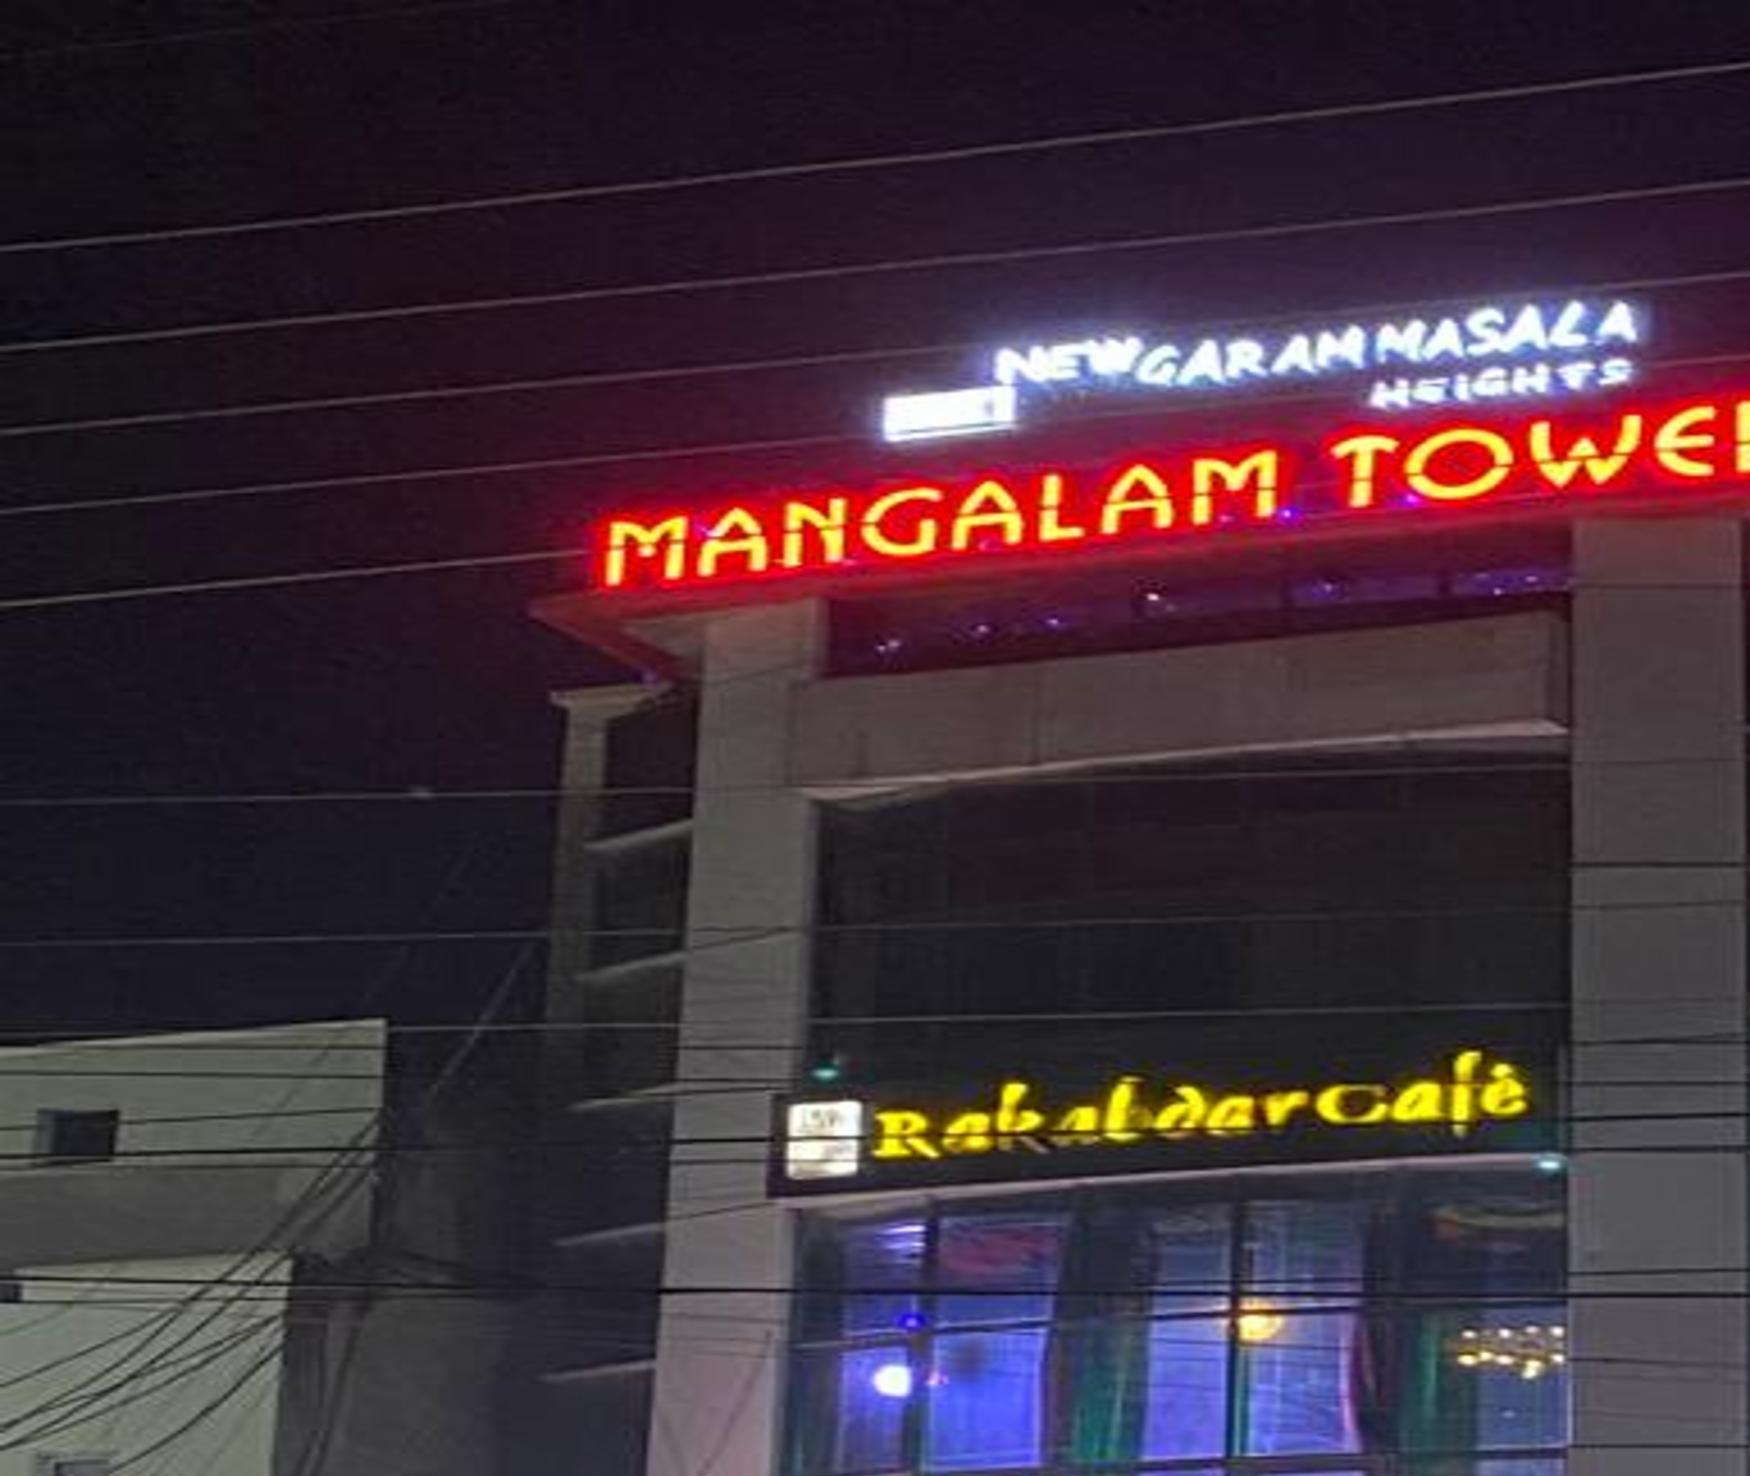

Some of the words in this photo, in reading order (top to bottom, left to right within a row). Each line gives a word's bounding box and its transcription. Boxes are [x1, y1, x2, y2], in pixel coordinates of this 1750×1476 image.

[995, 336, 1143, 386] NEW
[1137, 323, 1364, 385] GARAM
[1376, 300, 1638, 363] MASALA
[1369, 357, 1634, 408] HEIGHTS
[605, 450, 1277, 586] MANGALAM
